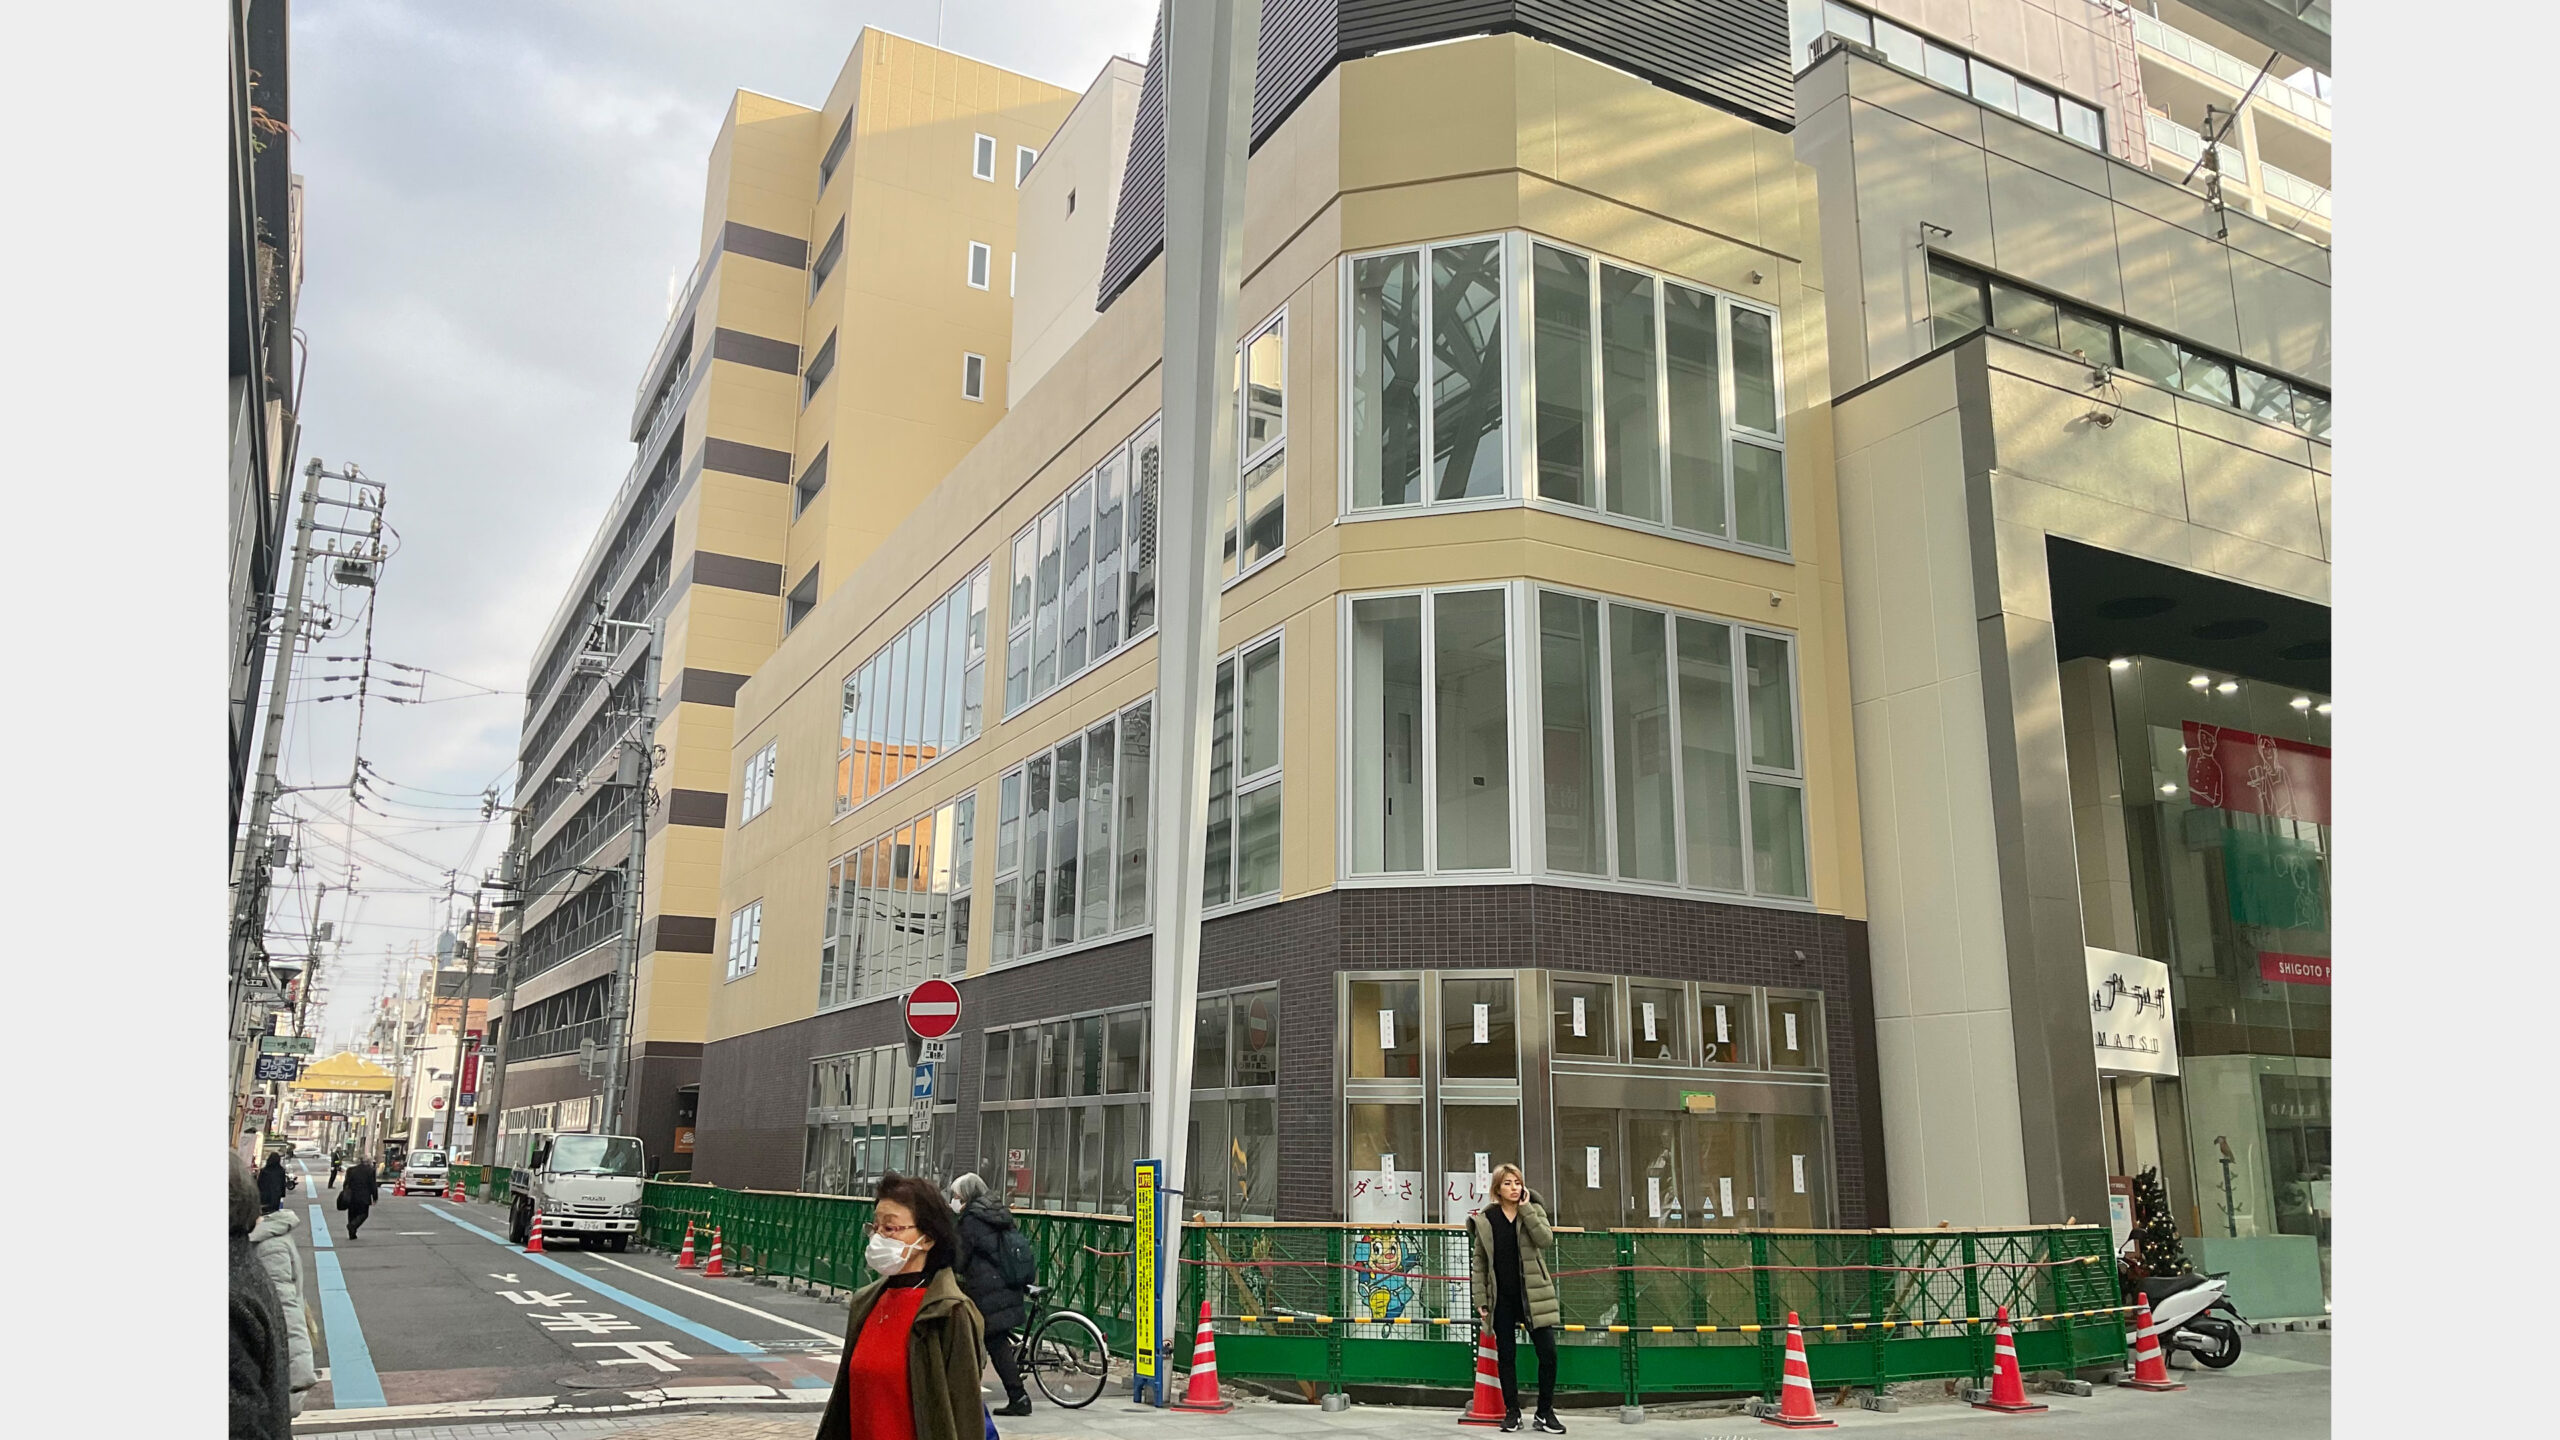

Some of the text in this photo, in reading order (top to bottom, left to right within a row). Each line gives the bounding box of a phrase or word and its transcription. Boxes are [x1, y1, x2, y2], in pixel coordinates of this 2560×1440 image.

[2278, 961, 2322, 978] SHIGOTO
[1965, 1390, 1979, 1401] NS
[1864, 1399, 1880, 1410] NS
